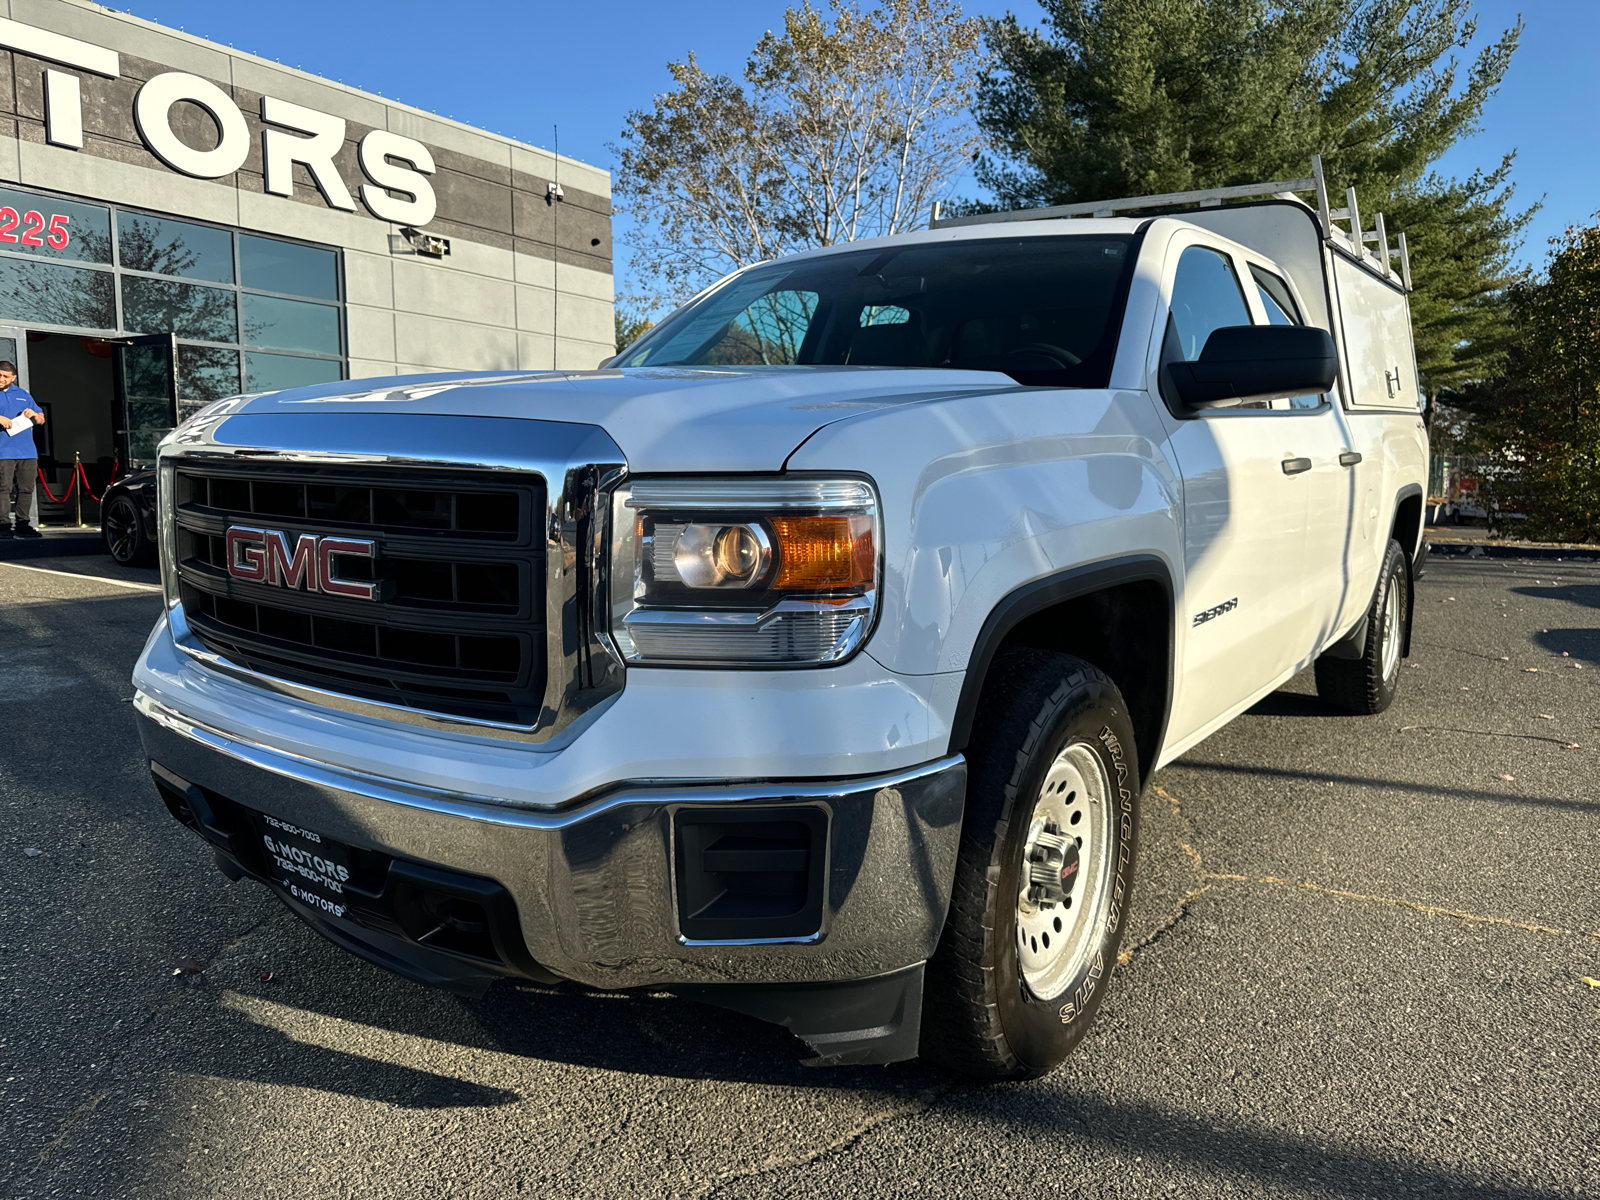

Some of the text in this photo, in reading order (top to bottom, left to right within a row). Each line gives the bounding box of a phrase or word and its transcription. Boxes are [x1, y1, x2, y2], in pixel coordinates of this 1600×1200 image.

[0, 16, 437, 226] TORS
[226, 525, 376, 601] GMC
[1192, 597, 1238, 628] SIERRA
[263, 814, 321, 844] 732-800-7003
[1099, 725, 1131, 934] WRANGLER
[273, 854, 343, 893] 732-800-700
